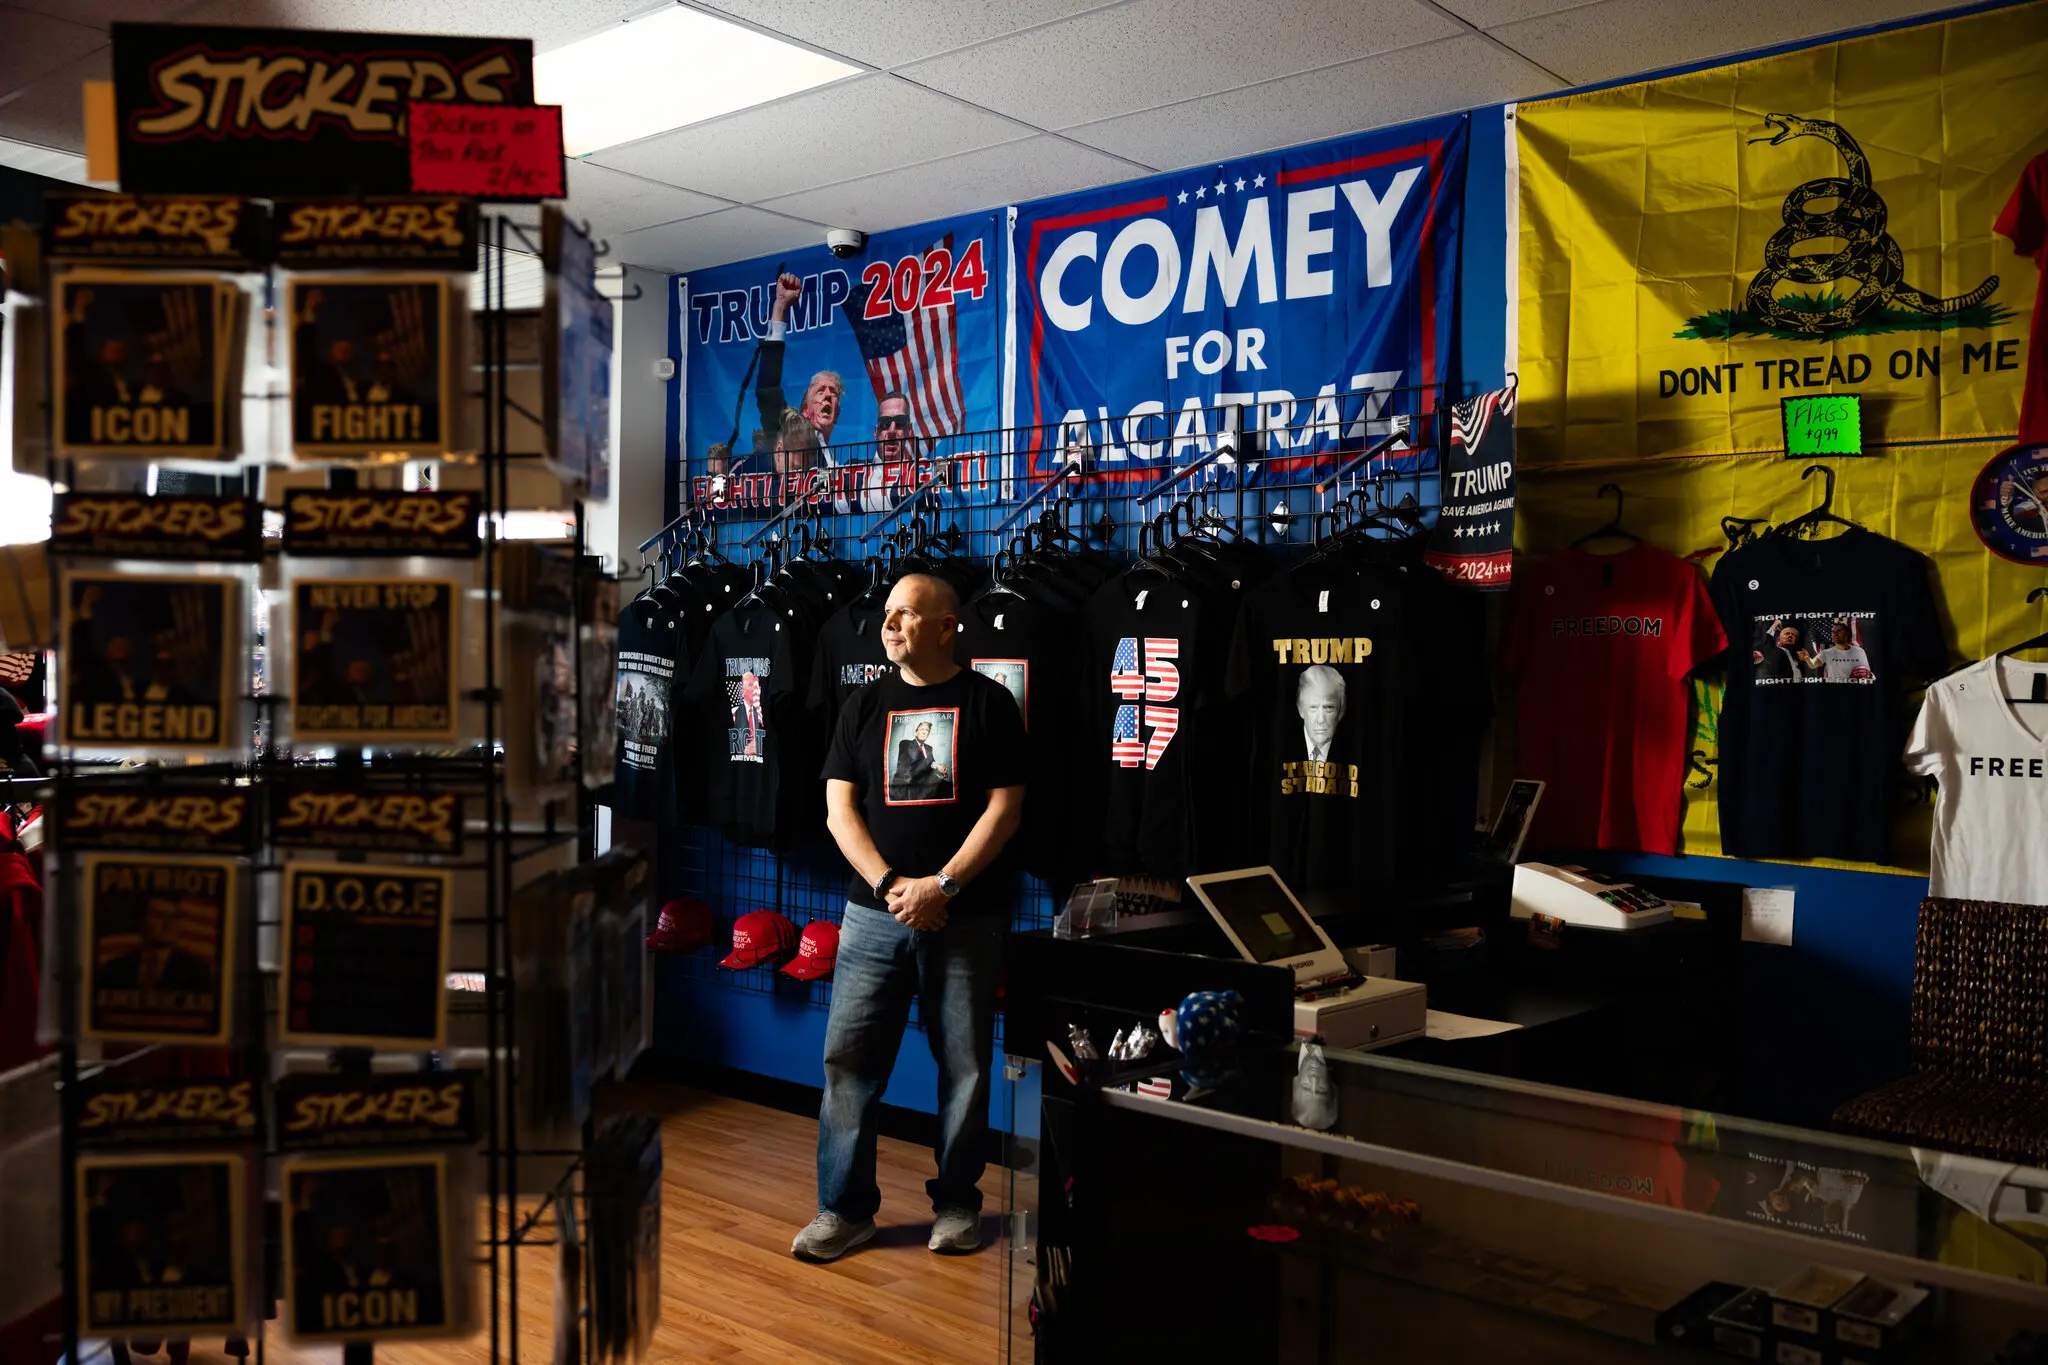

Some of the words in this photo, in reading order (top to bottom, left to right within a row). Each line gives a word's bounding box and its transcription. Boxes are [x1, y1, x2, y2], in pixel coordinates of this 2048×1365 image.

[55, 200, 240, 240] STICKERS
[281, 202, 461, 242] STICKERS
[1040, 166, 1423, 331] COMEY
[692, 269, 850, 344] TRUMP
[862, 239, 988, 320] 2024
[1165, 328, 1267, 379] FOR
[1659, 362, 1744, 399] DONT
[1755, 354, 1871, 390] TREAD
[1888, 347, 1941, 377] ON
[1963, 339, 2020, 374] ME
[91, 406, 190, 443] ICON
[309, 403, 423, 441] FIGHT!
[1052, 370, 1404, 464] ALCATRAZ
[1451, 461, 1512, 498] TRUMP
[56, 500, 248, 540] STICKERS
[290, 496, 468, 534] STICKERS
[1442, 505, 1465, 516] SAVE
[1466, 502, 1493, 516] AMERICA
[2001, 507, 2017, 529] MAKE
[1456, 560, 1493, 580] 2024
[1552, 615, 1663, 639] FREEDOM
[1754, 613, 1792, 622] FIGHT
[1795, 612, 1835, 620] FIGHT
[1838, 611, 1876, 619] FIGHT
[725, 658, 752, 677] TRUMP
[752, 657, 771, 677] WAS
[1110, 637, 1180, 702] 45
[1272, 637, 1373, 664] TRUMP
[1755, 677, 1791, 686] FIGHT
[1959, 683, 1965, 691] S
[71, 702, 215, 740] LEGEND
[1111, 704, 1180, 770] 47
[641, 744, 657, 755] FREED
[1970, 757, 2043, 778] FREE
[66, 794, 244, 831] STICKERS
[275, 792, 451, 833] STICKERS
[99, 869, 220, 895] PATRIOT
[85, 1083, 255, 1128] STICKERS
[292, 1085, 463, 1131] STICKERS
[322, 1287, 418, 1329] ICON
